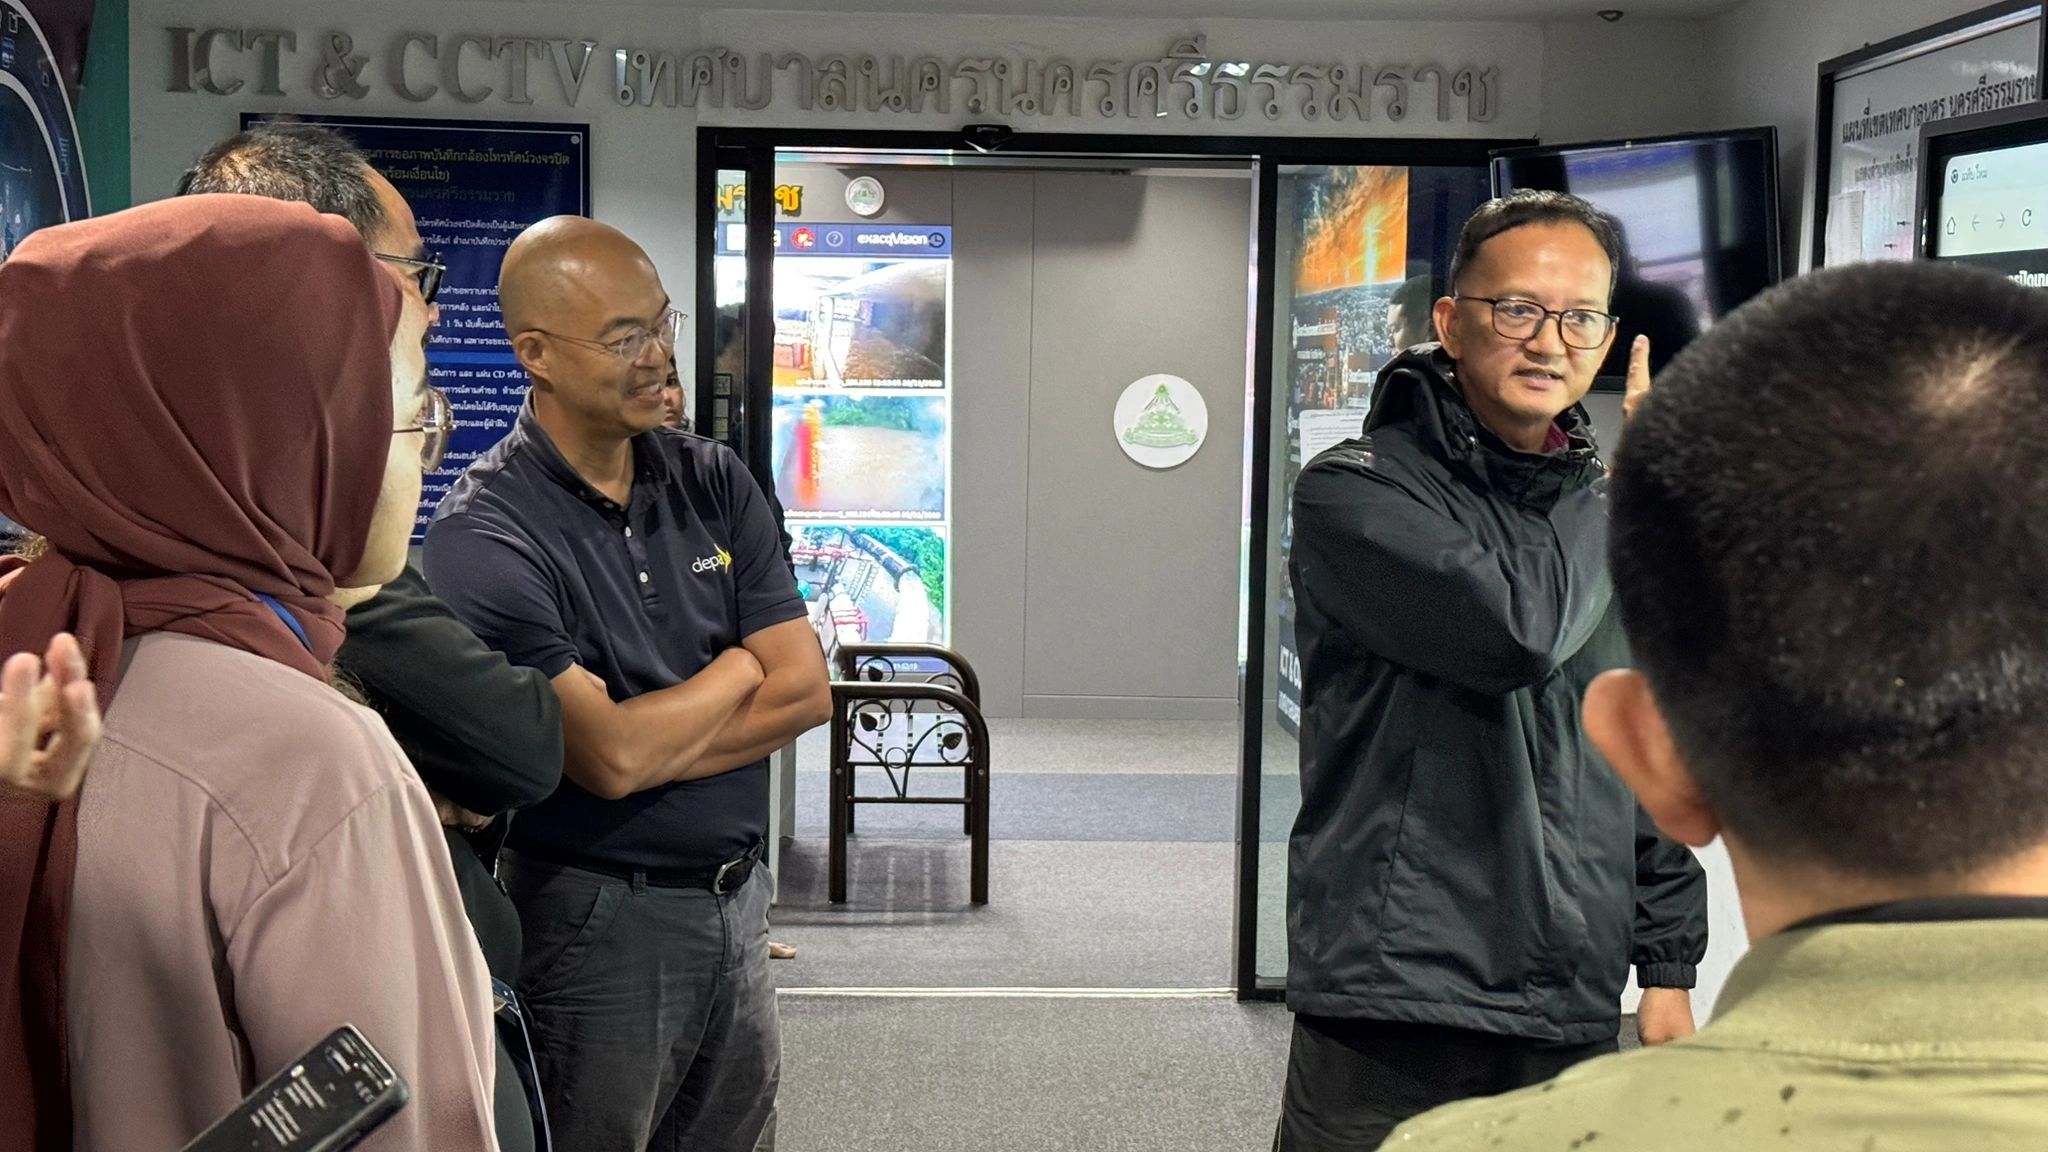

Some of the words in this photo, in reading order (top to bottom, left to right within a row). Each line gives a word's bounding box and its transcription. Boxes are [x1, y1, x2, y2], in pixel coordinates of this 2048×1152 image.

[164, 26, 297, 96] ICT
[313, 31, 371, 99] &
[397, 33, 596, 106] CCTV
[856, 232, 929, 246] exacqVision
[492, 370, 505, 379] CD
[692, 554, 725, 573] depa
